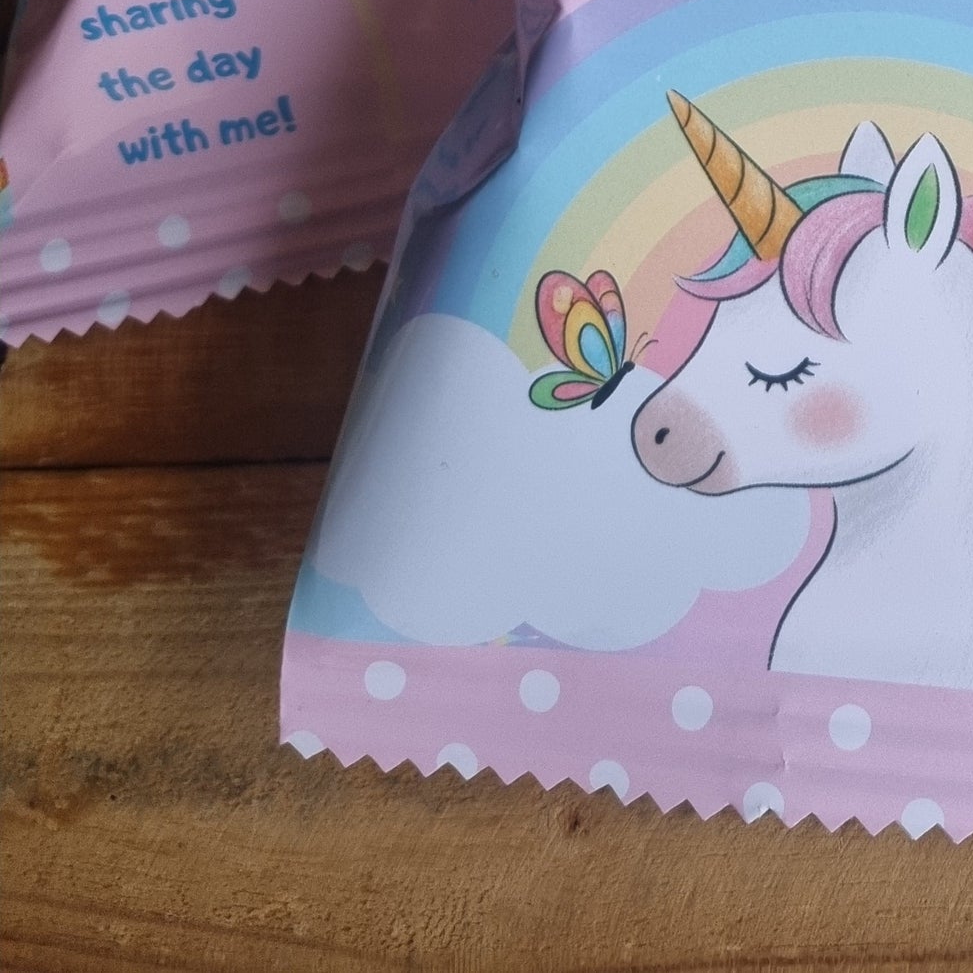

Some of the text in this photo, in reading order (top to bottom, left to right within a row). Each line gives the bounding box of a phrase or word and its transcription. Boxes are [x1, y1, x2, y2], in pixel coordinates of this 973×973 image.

[98, 46, 262, 102] the day
[117, 95, 298, 165] with me!
